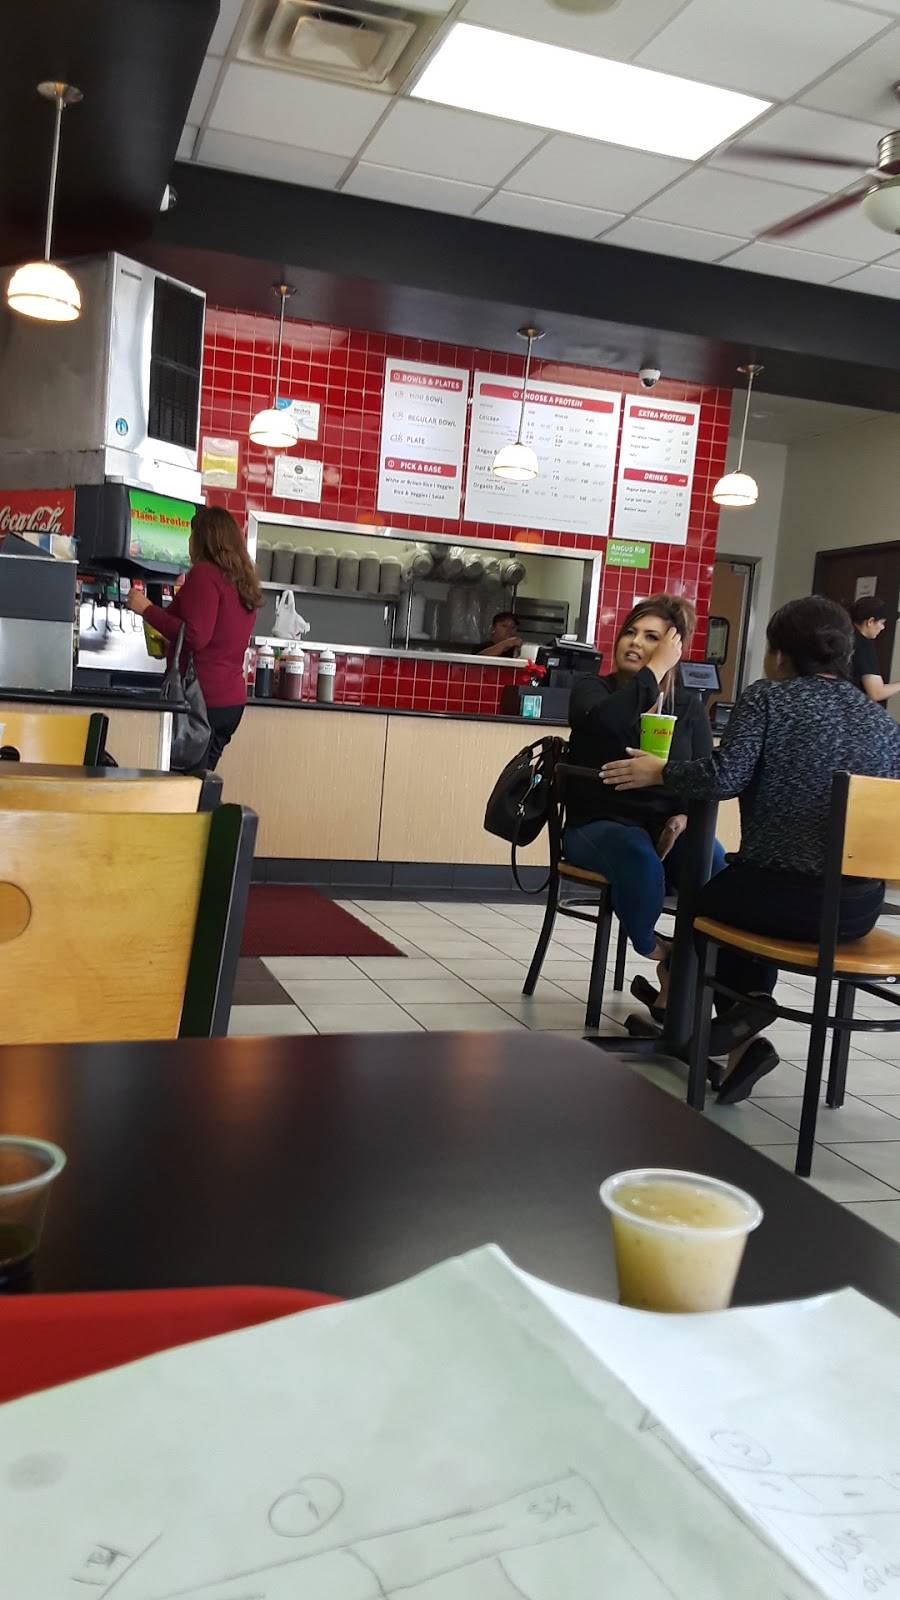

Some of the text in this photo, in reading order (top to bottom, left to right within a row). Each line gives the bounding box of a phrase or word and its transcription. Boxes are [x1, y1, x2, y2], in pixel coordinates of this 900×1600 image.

[402, 374, 460, 390] BOWLS & PLATES
[425, 394, 444, 404] BOWL
[548, 395, 554, 404] A
[554, 397, 583, 408] PROTEIN
[407, 414, 437, 425] REGULAR
[438, 418, 457, 428] BOWL
[638, 409, 687, 423] EXTRA PROTEIN
[406, 435, 426, 446] PLATE
[400, 461, 443, 474] PICK A BASE
[643, 473, 669, 483] DRINKS
